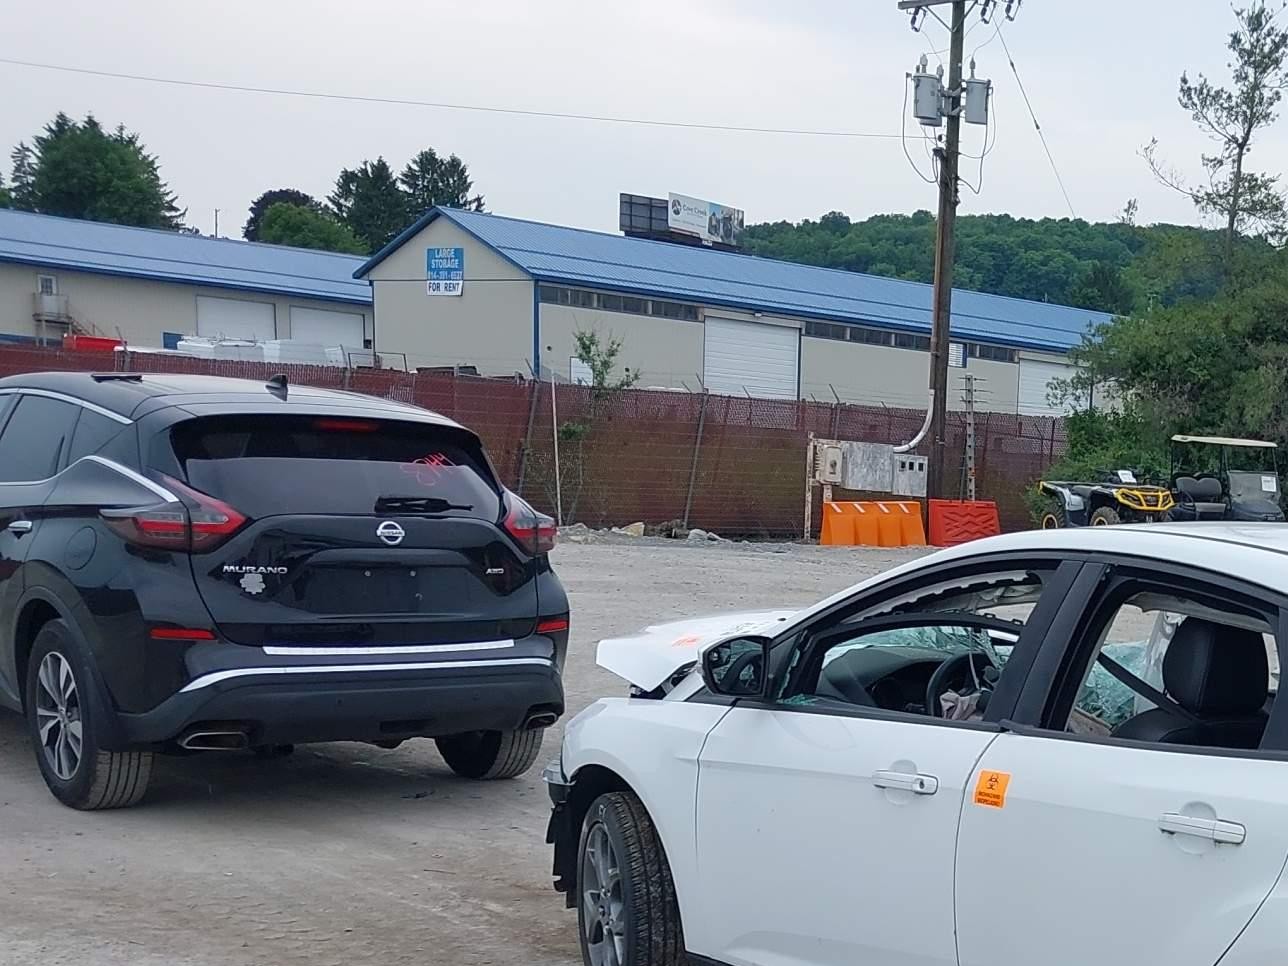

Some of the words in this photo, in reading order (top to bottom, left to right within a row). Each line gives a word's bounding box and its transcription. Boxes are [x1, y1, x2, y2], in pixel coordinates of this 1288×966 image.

[434, 248, 456, 258] LARGE
[431, 258, 460, 269] STORAGE
[428, 281, 441, 292] FOR
[443, 281, 460, 292] RENT
[222, 565, 288, 574] MURANO
